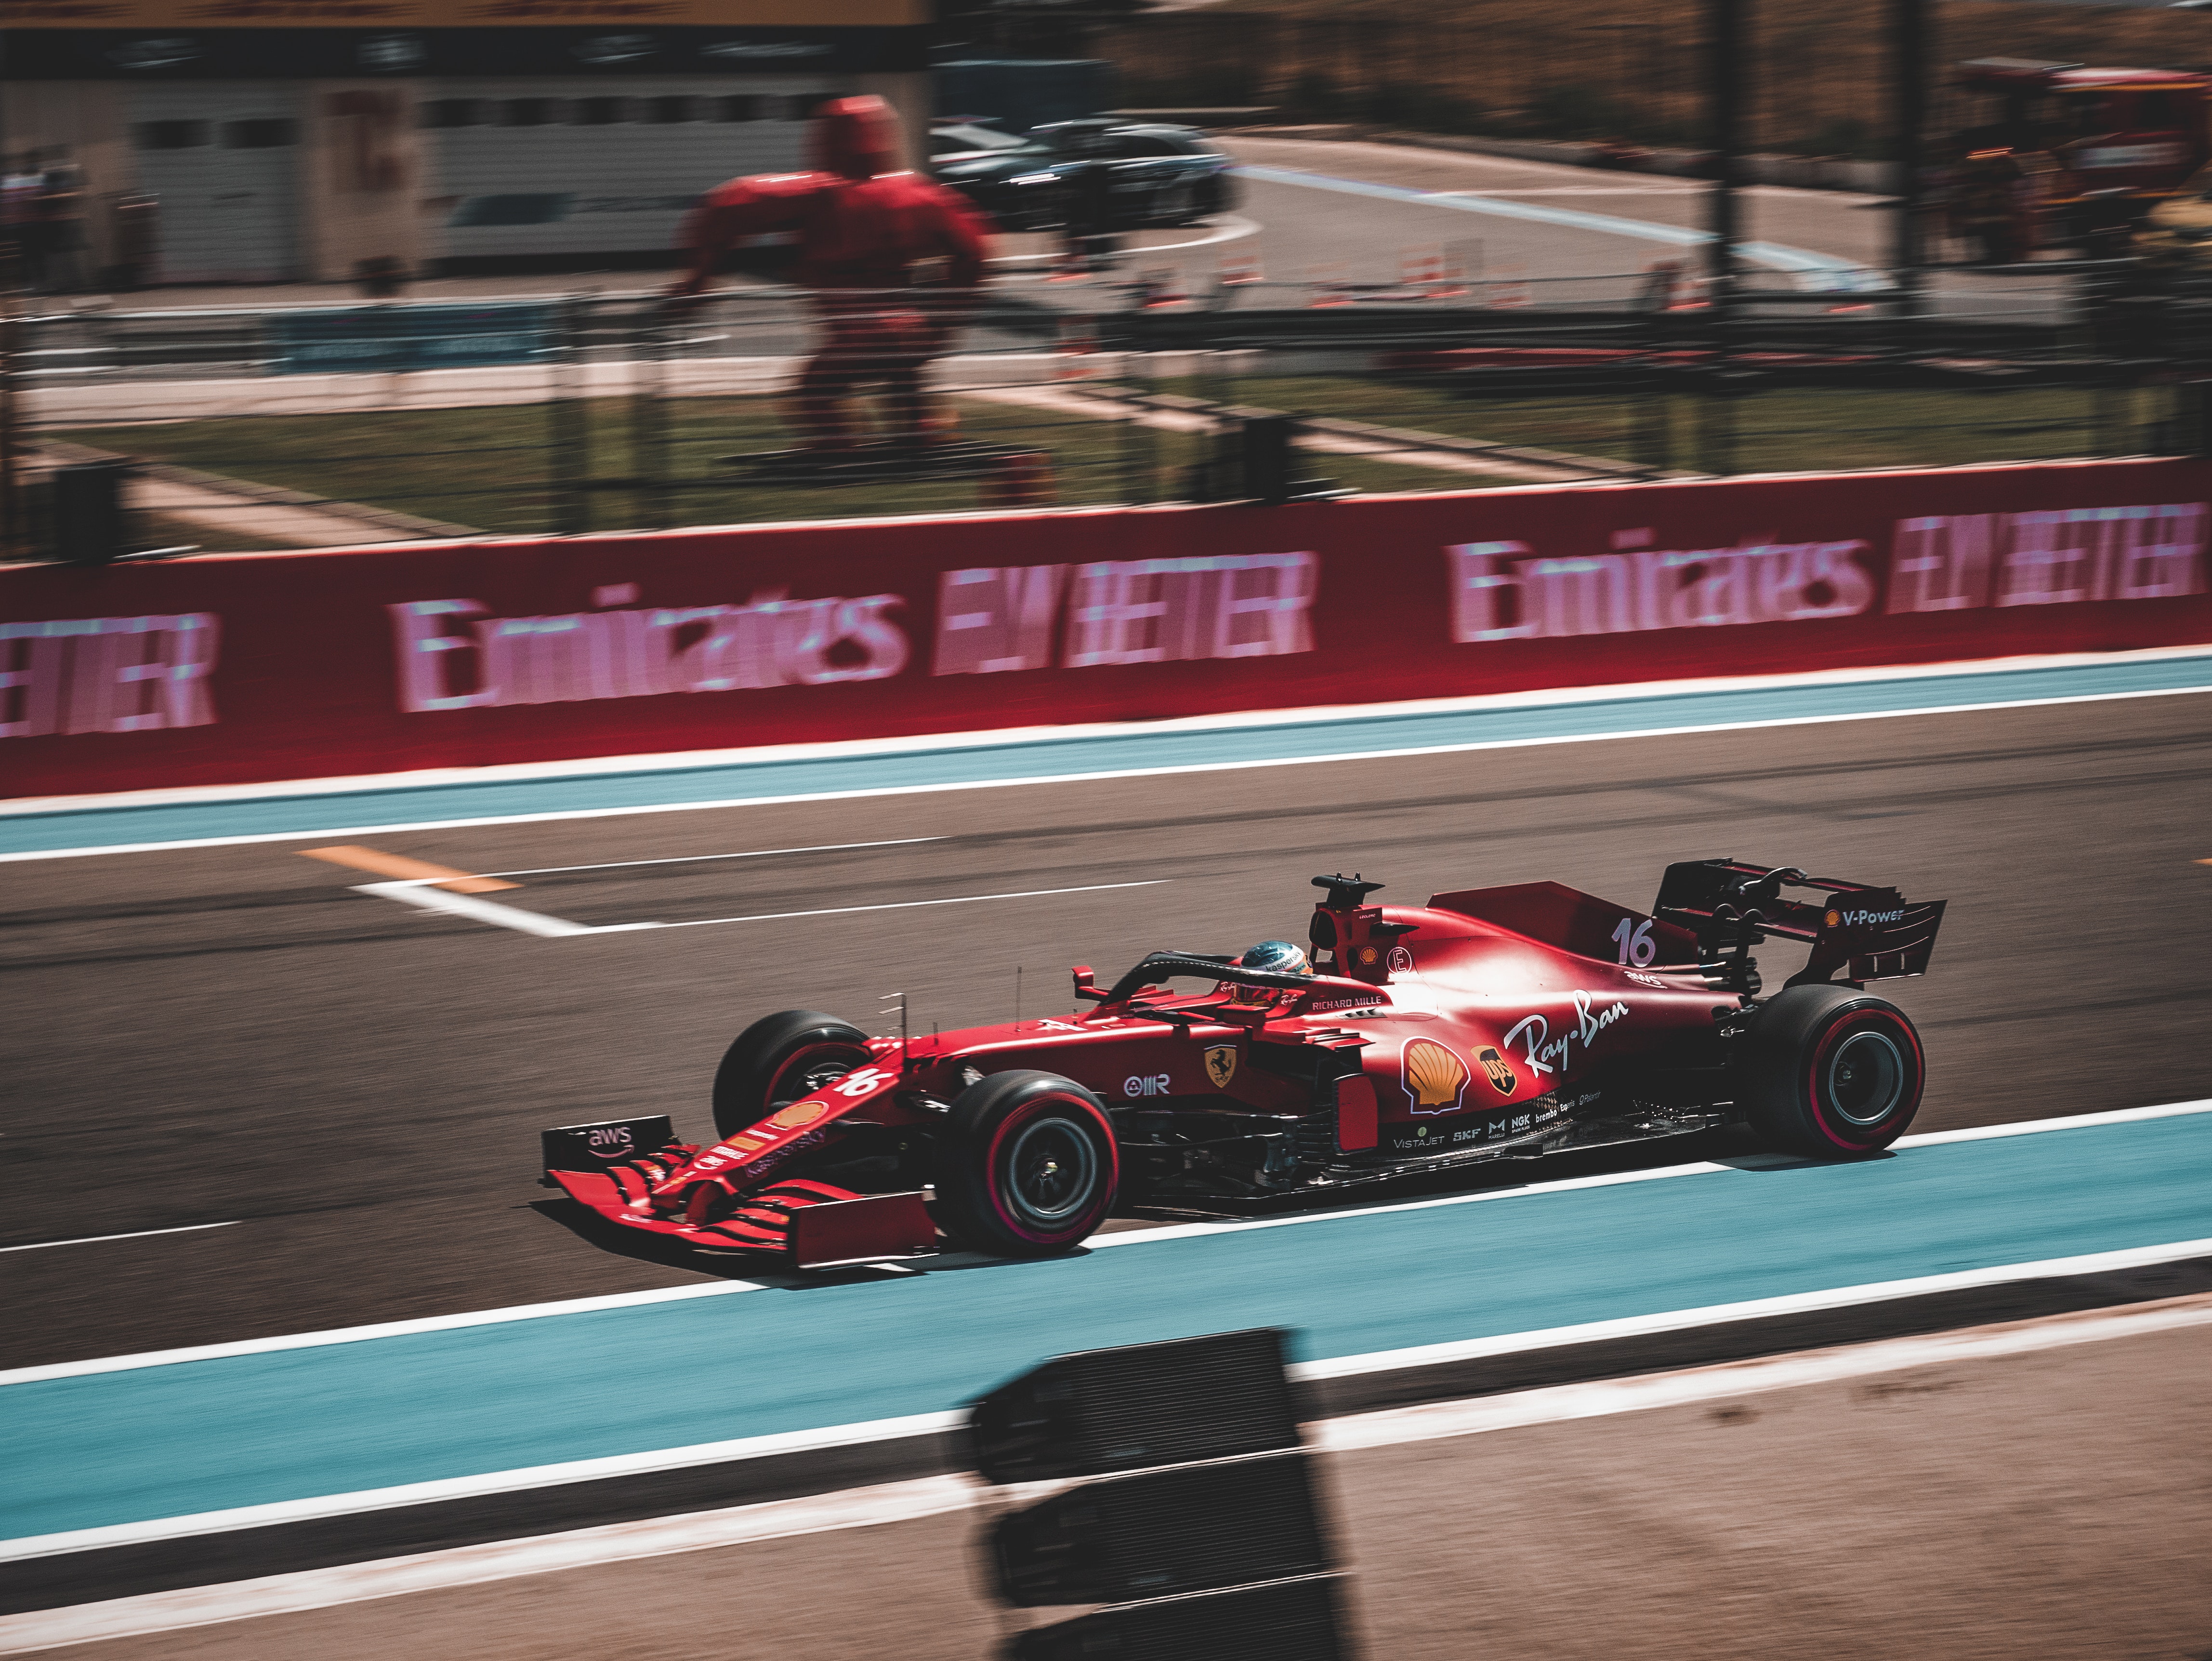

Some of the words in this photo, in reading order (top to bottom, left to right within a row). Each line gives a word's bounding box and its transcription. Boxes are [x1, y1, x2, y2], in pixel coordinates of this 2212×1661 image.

[386, 582, 909, 713] Emirates
[1843, 910, 1905, 925] V-Power
[1611, 918, 1656, 968] 16
[1624, 971, 1661, 985] aws
[1312, 999, 1352, 1010] RICHARD
[1355, 996, 1382, 1006] MILLE
[1481, 1059, 1513, 1087] ups
[832, 1068, 895, 1096] 16
[1560, 1099, 1575, 1112] Experis
[1512, 1114, 1530, 1129] NGK
[1536, 1108, 1557, 1123] brembo
[589, 1127, 632, 1146] aws
[1453, 1128, 1481, 1141] SKF
